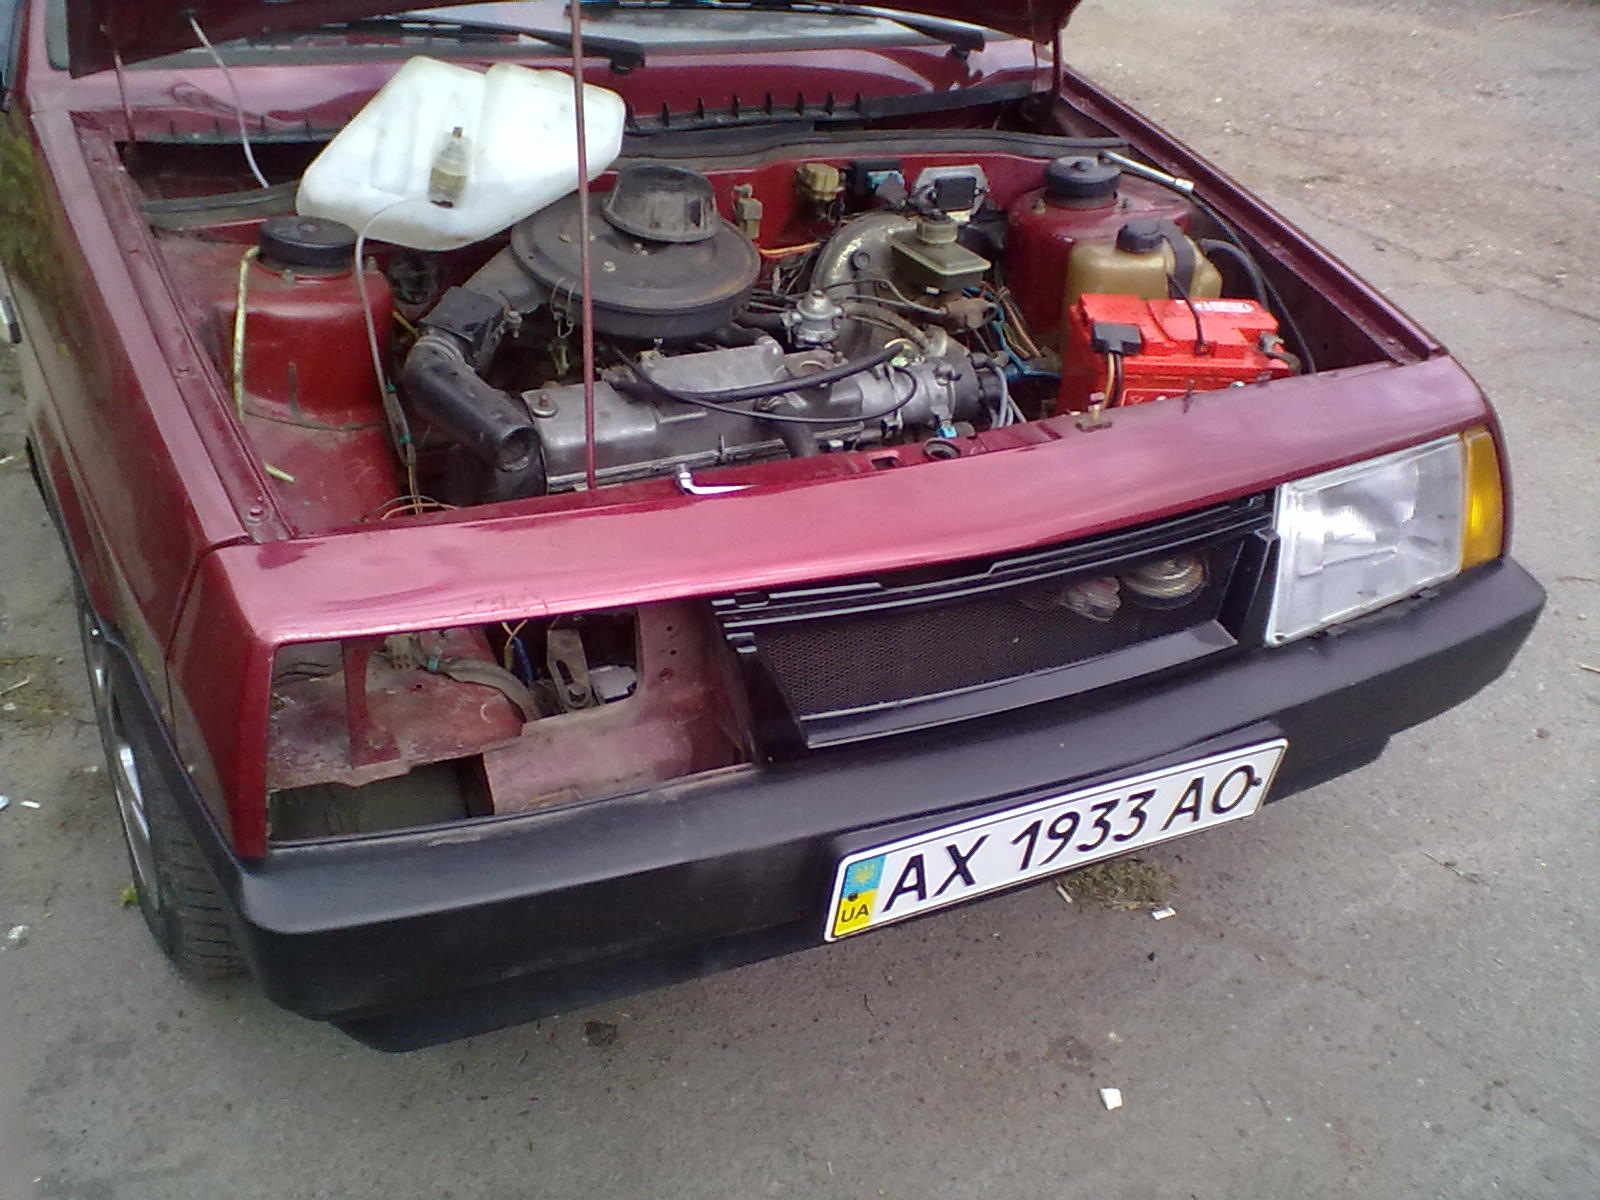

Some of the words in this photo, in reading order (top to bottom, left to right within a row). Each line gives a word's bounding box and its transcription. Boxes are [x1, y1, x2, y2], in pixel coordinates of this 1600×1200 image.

[882, 834, 989, 912] AX
[1011, 788, 1157, 870] 1933
[1160, 764, 1256, 832] AO
[841, 903, 870, 923] UA
